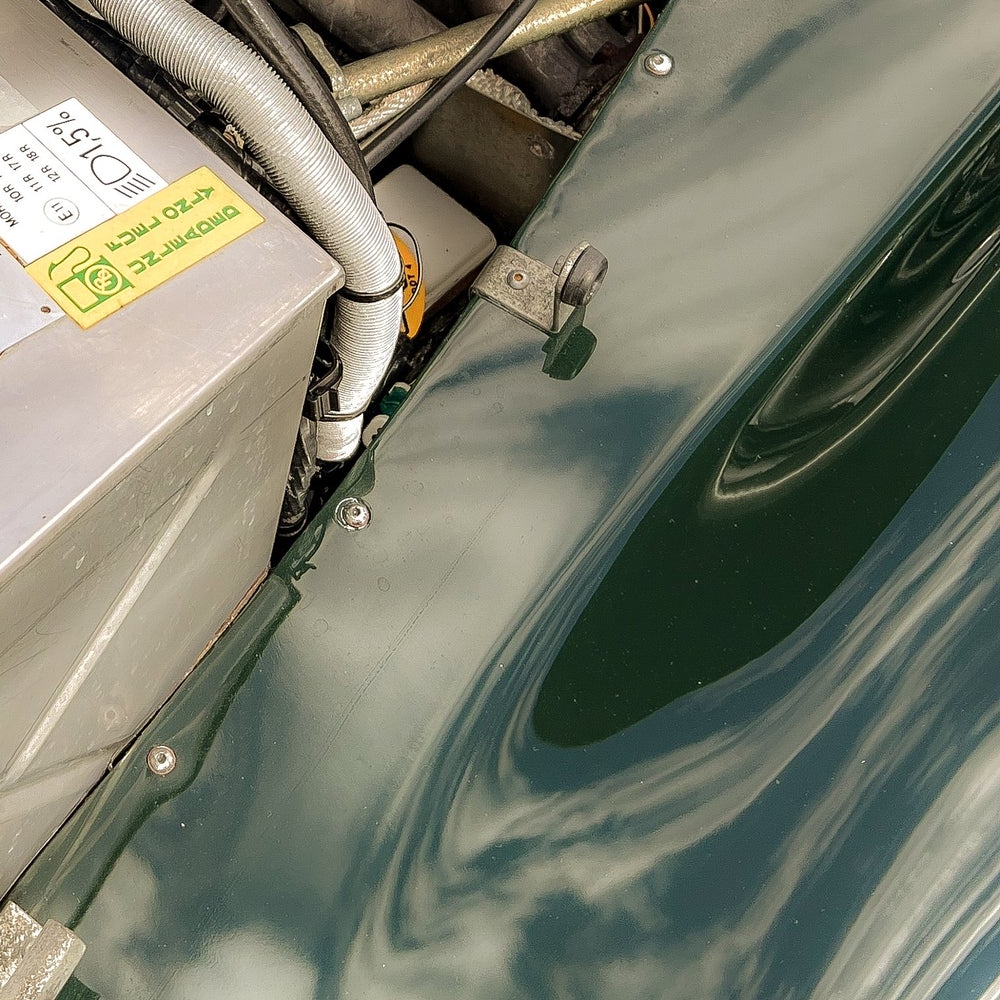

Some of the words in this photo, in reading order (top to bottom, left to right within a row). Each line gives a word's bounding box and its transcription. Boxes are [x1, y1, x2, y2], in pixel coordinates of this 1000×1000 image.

[105, 216, 161, 252] FUEL
[162, 187, 214, 219] ONLY
[127, 206, 240, 274] UNLEADED
